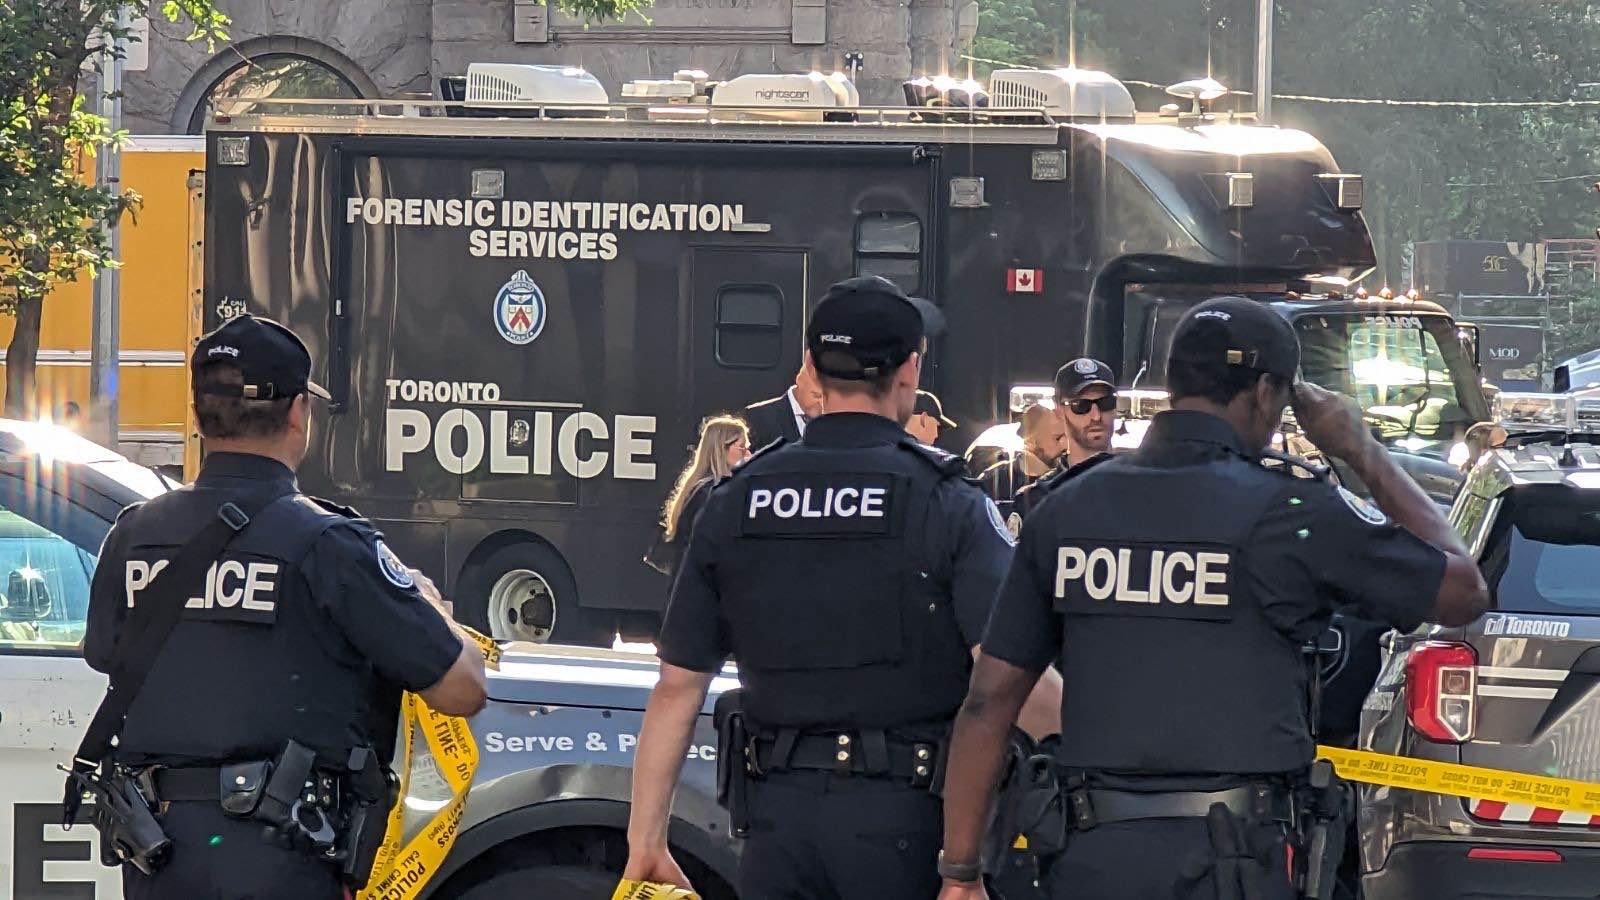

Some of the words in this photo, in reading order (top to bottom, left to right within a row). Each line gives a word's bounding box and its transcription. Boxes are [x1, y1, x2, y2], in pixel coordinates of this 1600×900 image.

[755, 88, 810, 100] nightscan
[346, 197, 496, 227] FORENSIC
[501, 200, 744, 232] IDENTIFICATION
[469, 229, 618, 260] SERVICES
[1489, 347, 1520, 358] MOD
[385, 379, 500, 402] TORONTO
[385, 408, 657, 480] POLICE
[749, 487, 886, 519] POLICE
[1055, 546, 1230, 606] POLICE
[1505, 616, 1571, 638] TORONTO
[485, 731, 574, 753] Serve
[585, 732, 608, 752] &
